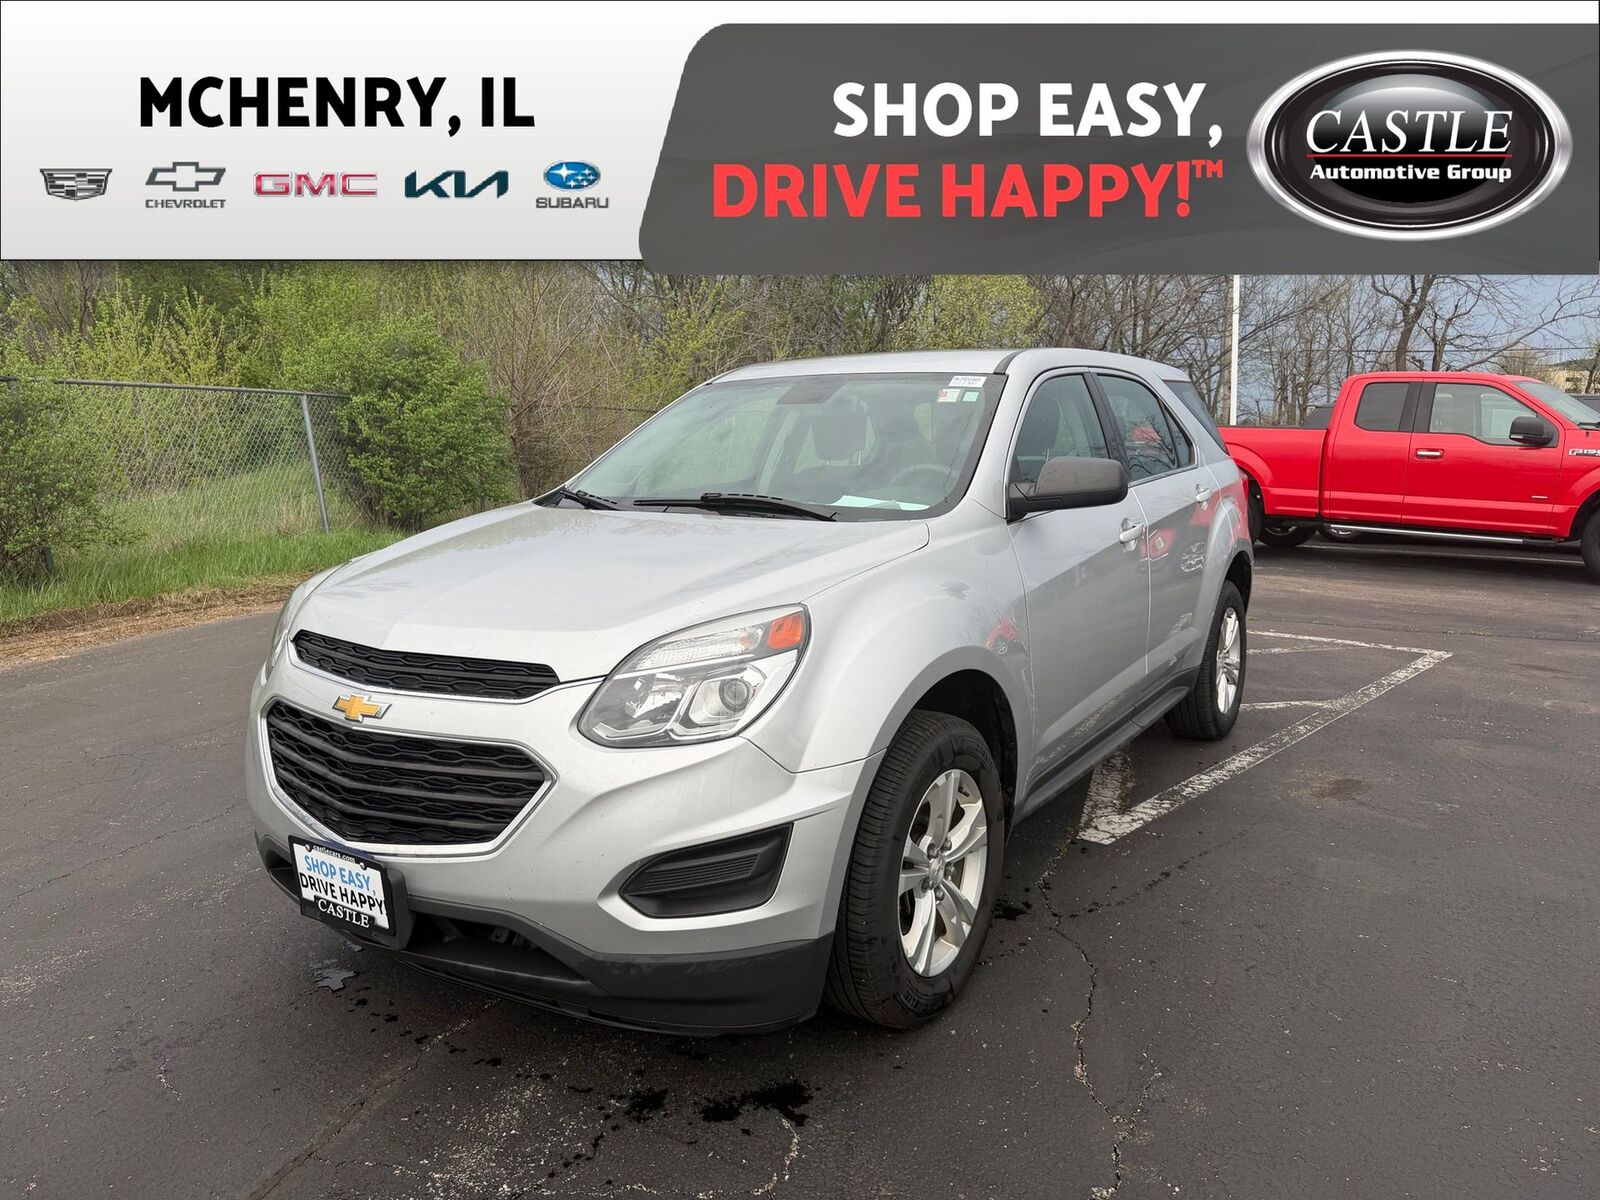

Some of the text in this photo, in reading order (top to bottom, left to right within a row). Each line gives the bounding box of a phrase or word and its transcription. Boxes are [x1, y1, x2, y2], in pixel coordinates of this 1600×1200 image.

[304, 855, 337, 879] SHOP
[299, 872, 384, 915] DRIVE HAPPY
[317, 898, 370, 928] CASTLE
